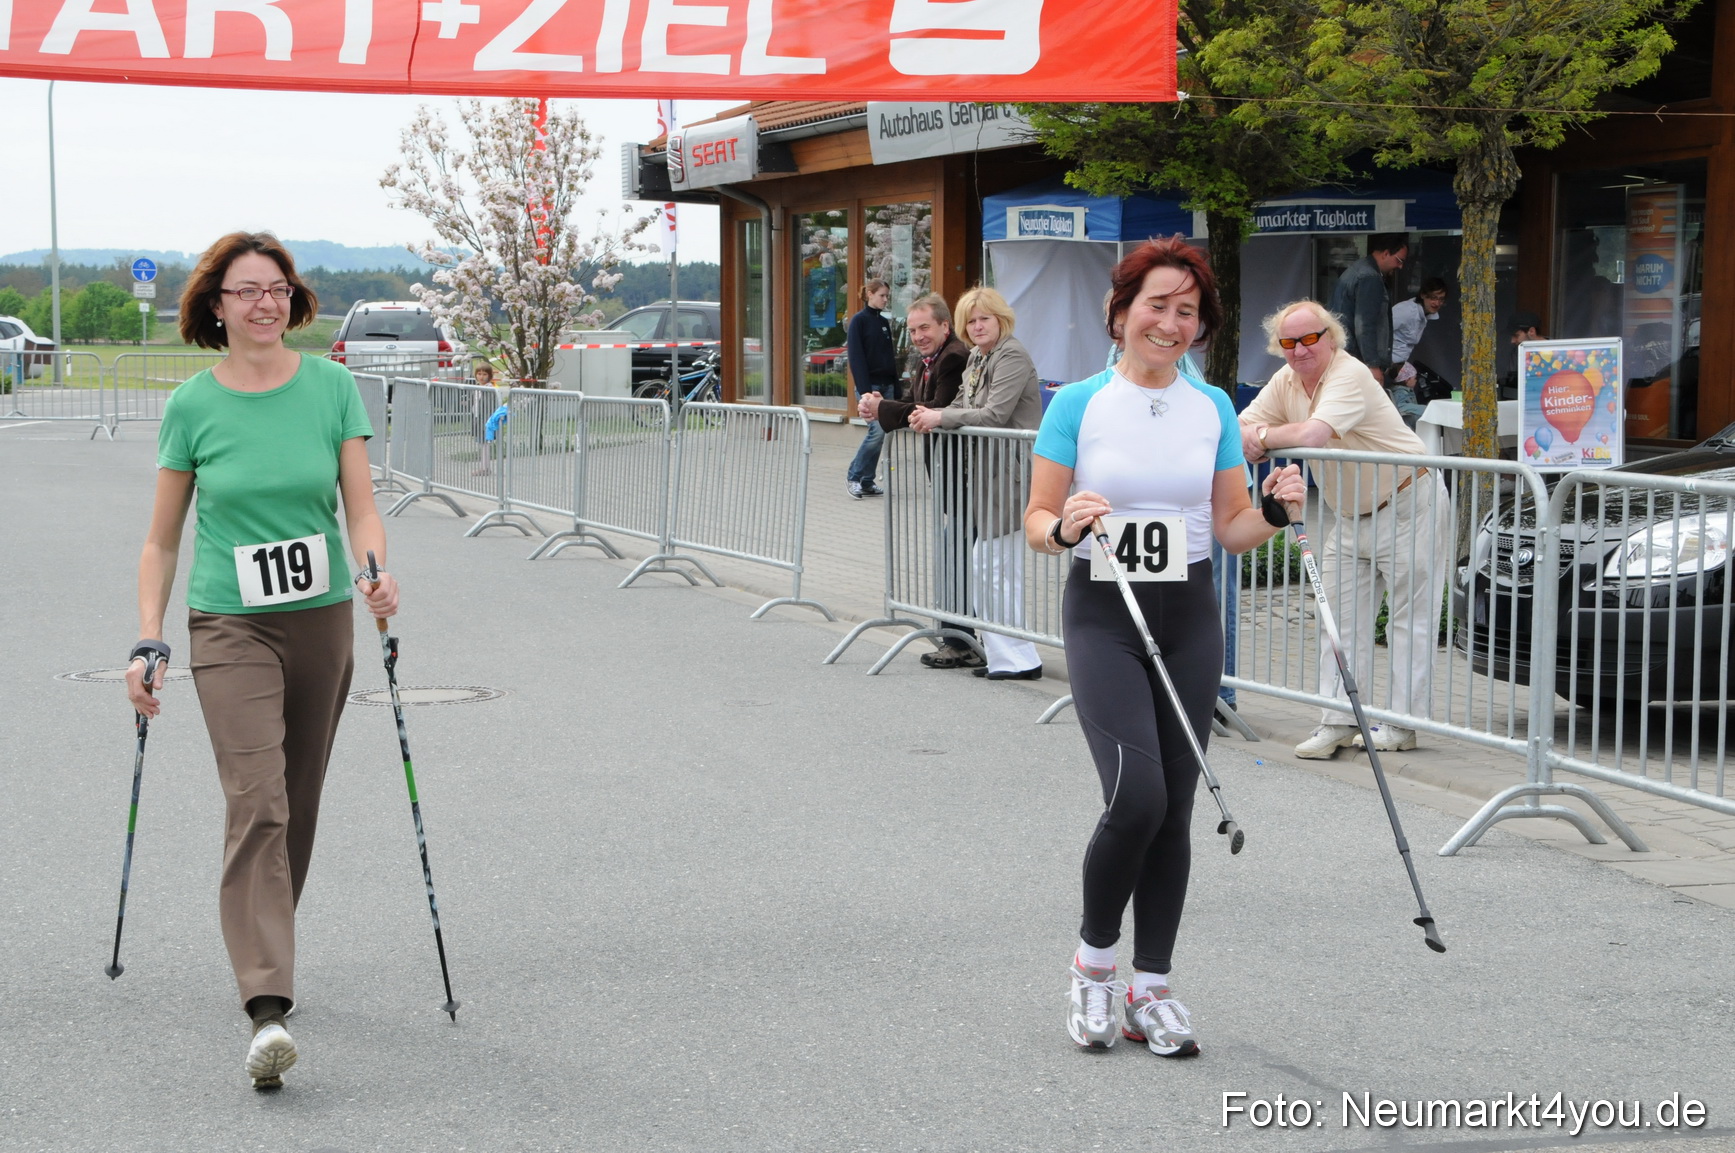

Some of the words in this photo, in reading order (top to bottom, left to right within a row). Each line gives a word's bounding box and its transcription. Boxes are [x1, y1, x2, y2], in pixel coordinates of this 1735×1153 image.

[880, 106, 944, 140] Autohaus
[692, 138, 738, 168] SEAT
[1313, 209, 1368, 228] Tagblatt
[1635, 263, 1664, 274] WARUM
[1635, 275, 1662, 286] NICHT?
[1548, 385, 1570, 394] Hier:
[1544, 394, 1593, 408] Kinder-
[1546, 404, 1592, 415] schminken
[1115, 521, 1168, 573] 49
[252, 541, 313, 597] 119
